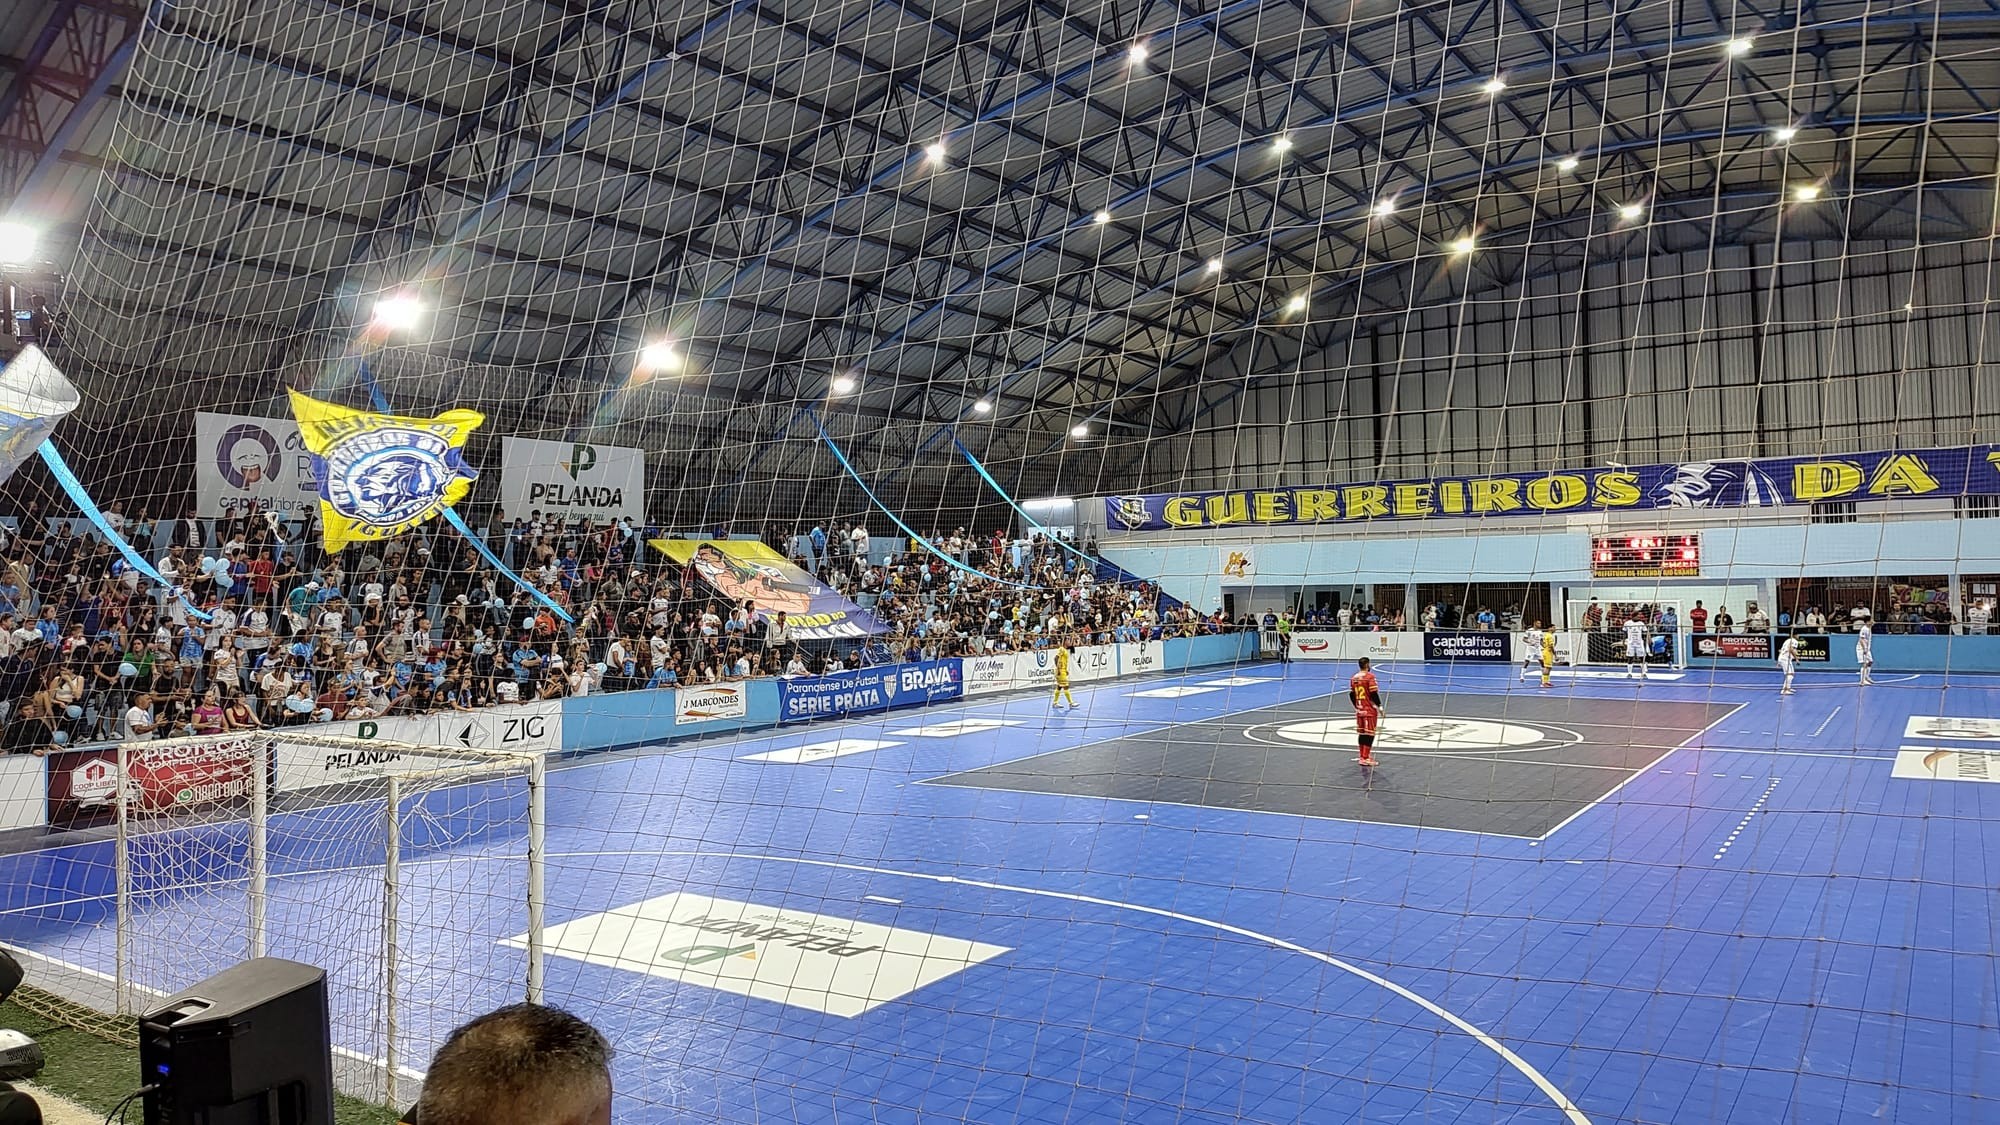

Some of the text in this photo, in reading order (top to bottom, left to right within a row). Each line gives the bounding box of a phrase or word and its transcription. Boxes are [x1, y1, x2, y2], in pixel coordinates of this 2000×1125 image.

[529, 482, 623, 508] PELANDA
[1162, 471, 1640, 527] GUERREIROS
[1791, 454, 1940, 500] DA
[1432, 636, 1502, 648] capitalfibra
[1091, 651, 1107, 667] ZIG
[1443, 648, 1502, 656] 0800 941 0094
[1132, 656, 1153, 666] PELANDA
[902, 666, 951, 692] BRAVA
[1028, 667, 1055, 678] UniCesuma
[787, 681, 840, 693] Paranaense
[842, 679, 854, 689] De
[683, 700, 689, 709] J
[690, 694, 739, 708] MARCONDES
[789, 689, 880, 715] SÉRIE PRATA
[503, 716, 544, 742] ZIG
[678, 915, 882, 957] PELANDA
